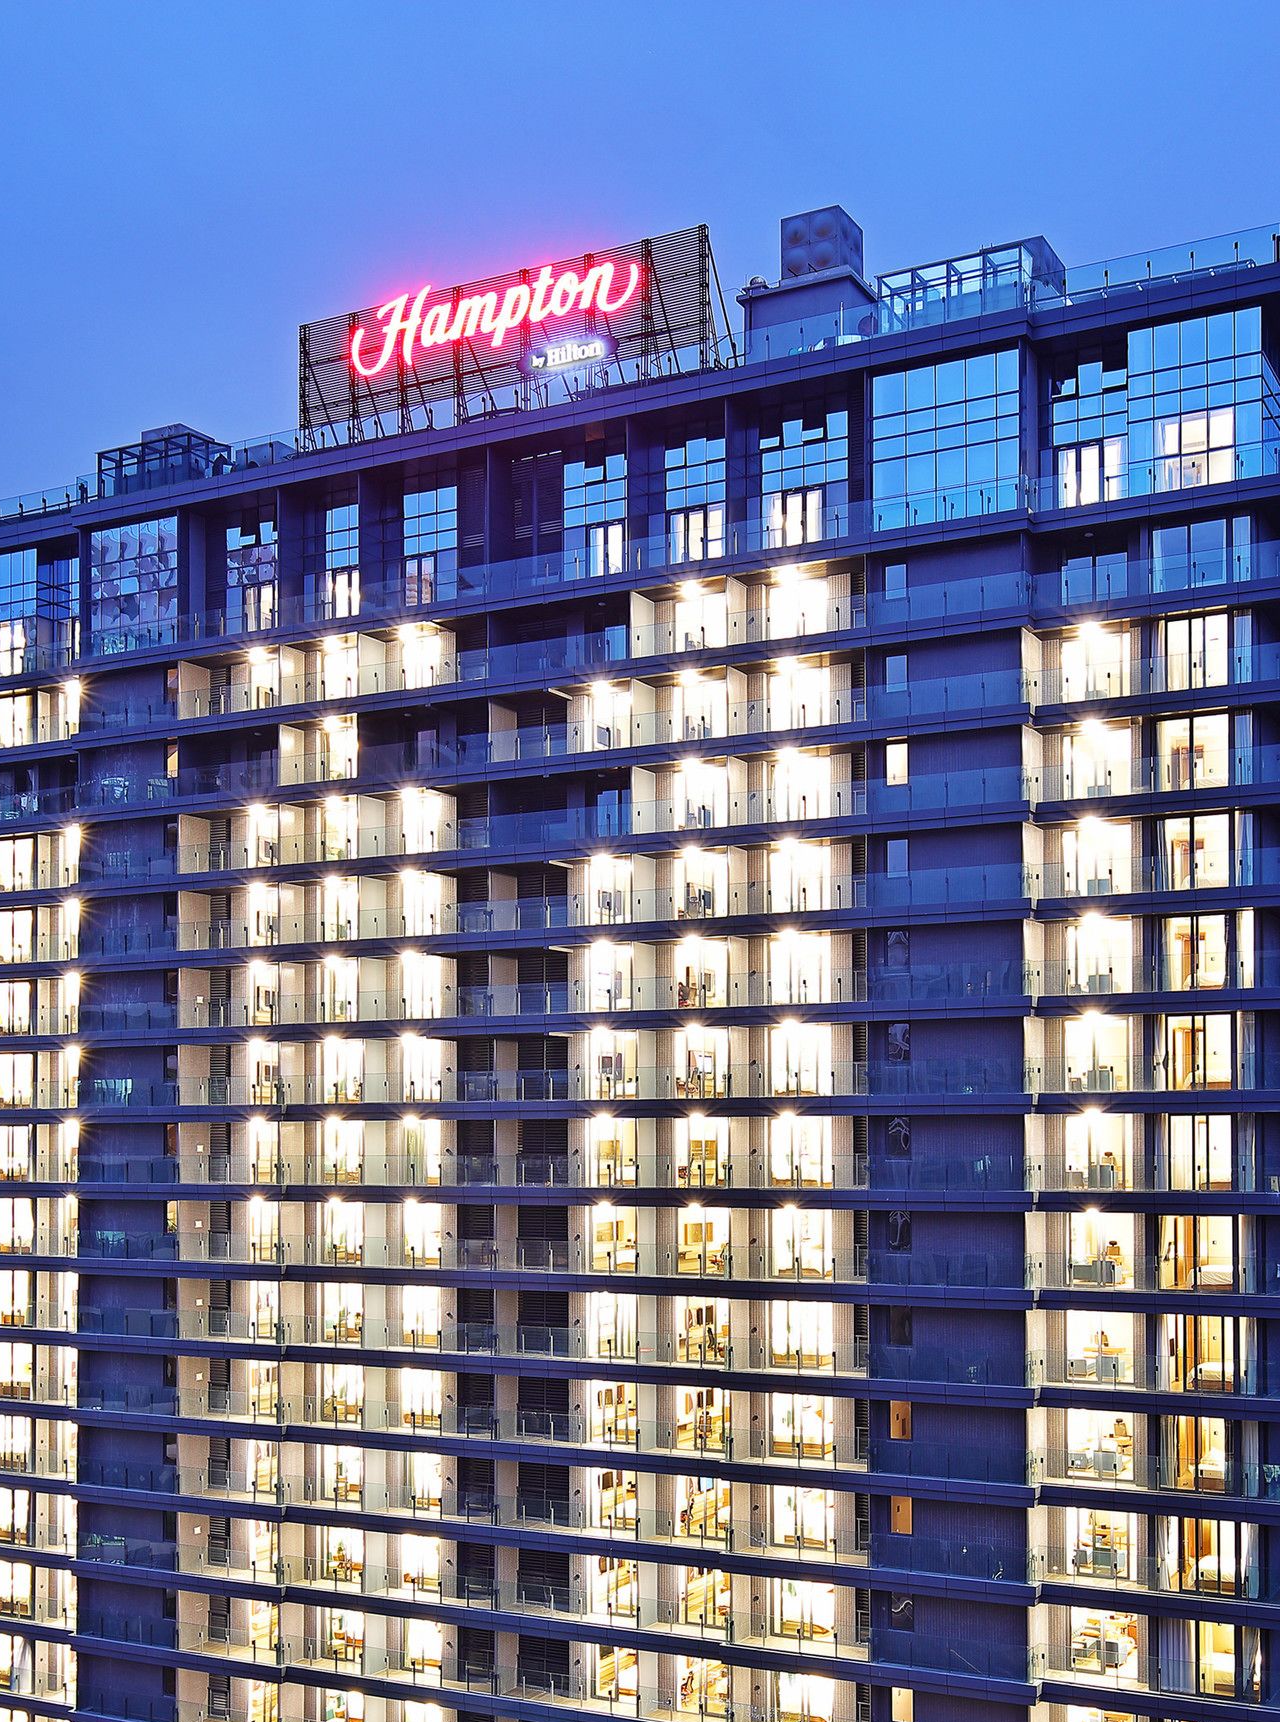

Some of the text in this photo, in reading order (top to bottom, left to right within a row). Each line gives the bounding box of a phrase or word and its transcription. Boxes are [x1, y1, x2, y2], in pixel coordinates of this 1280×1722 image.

[352, 262, 638, 376] Hampton
[531, 341, 602, 368] by Hilton
